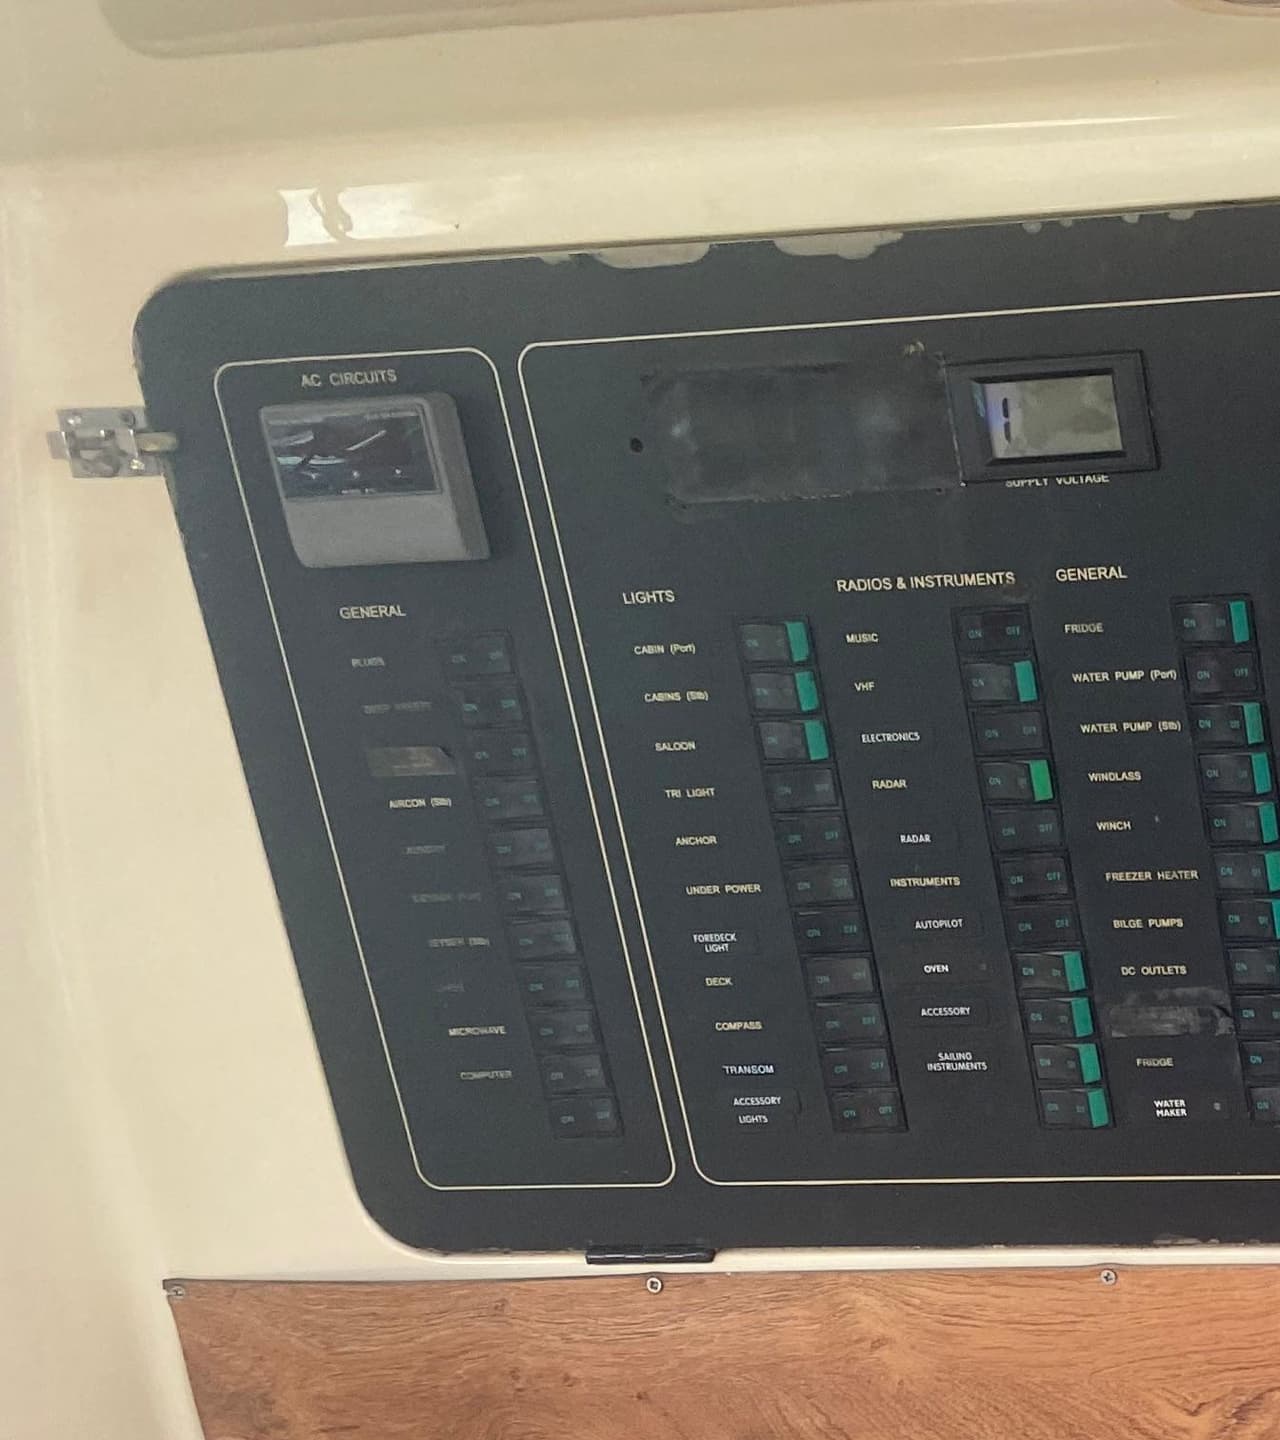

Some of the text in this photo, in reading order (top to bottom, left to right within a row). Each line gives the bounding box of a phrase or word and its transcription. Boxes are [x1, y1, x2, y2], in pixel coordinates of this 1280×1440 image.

[301, 369, 397, 388] AC CIRCUITS
[1056, 566, 1128, 582] GENERAL
[837, 571, 1016, 593] RADIOS & INSTRUMENTS
[622, 589, 675, 605] LIGHTS
[340, 604, 406, 619] GENERAL
[1064, 622, 1104, 634] FRIDGE
[846, 632, 879, 643] MUSIC
[634, 645, 665, 656] CABIN
[1072, 672, 1110, 683] WATER
[1115, 670, 1145, 682] PUMP
[854, 682, 875, 692] VHF
[1080, 723, 1118, 735] WATER
[1123, 721, 1152, 733] PUMP
[861, 732, 921, 744] ELECTRONICS
[655, 741, 697, 752] SALOON
[1088, 770, 1142, 783] WINDLASS
[872, 779, 908, 790] RADAR
[664, 787, 716, 799] TRI LIGHT
[1096, 820, 1132, 831] WINCH
[675, 835, 718, 847] ANCHOR
[900, 833, 932, 845] RADAR
[1105, 869, 1200, 883] FREEZER HEATER
[890, 876, 961, 888] INSTRUMENTS
[686, 884, 762, 896] UNDER POWER
[914, 918, 964, 930] AUTOPILOT
[1113, 917, 1184, 929] BILGE PUMPS
[692, 933, 737, 943] FOREDECK
[705, 943, 731, 953] LIGHT
[923, 964, 950, 975] OVEN
[1121, 964, 1187, 976] DC OUTLETS
[705, 976, 734, 987] DECK
[920, 1006, 970, 1017] ACCESSORY
[715, 1020, 763, 1031] COMPASS
[938, 1052, 973, 1062] SAILING
[1136, 1057, 1175, 1068] FRIDGE
[722, 1065, 774, 1075] TRANSOM
[927, 1061, 988, 1072] INSTRUMENTS
[733, 1096, 782, 1107] ACCESSORY
[1153, 1099, 1186, 1108] WATER
[1156, 1108, 1188, 1118] MAKER
[738, 1115, 768, 1125] LIGHTS
